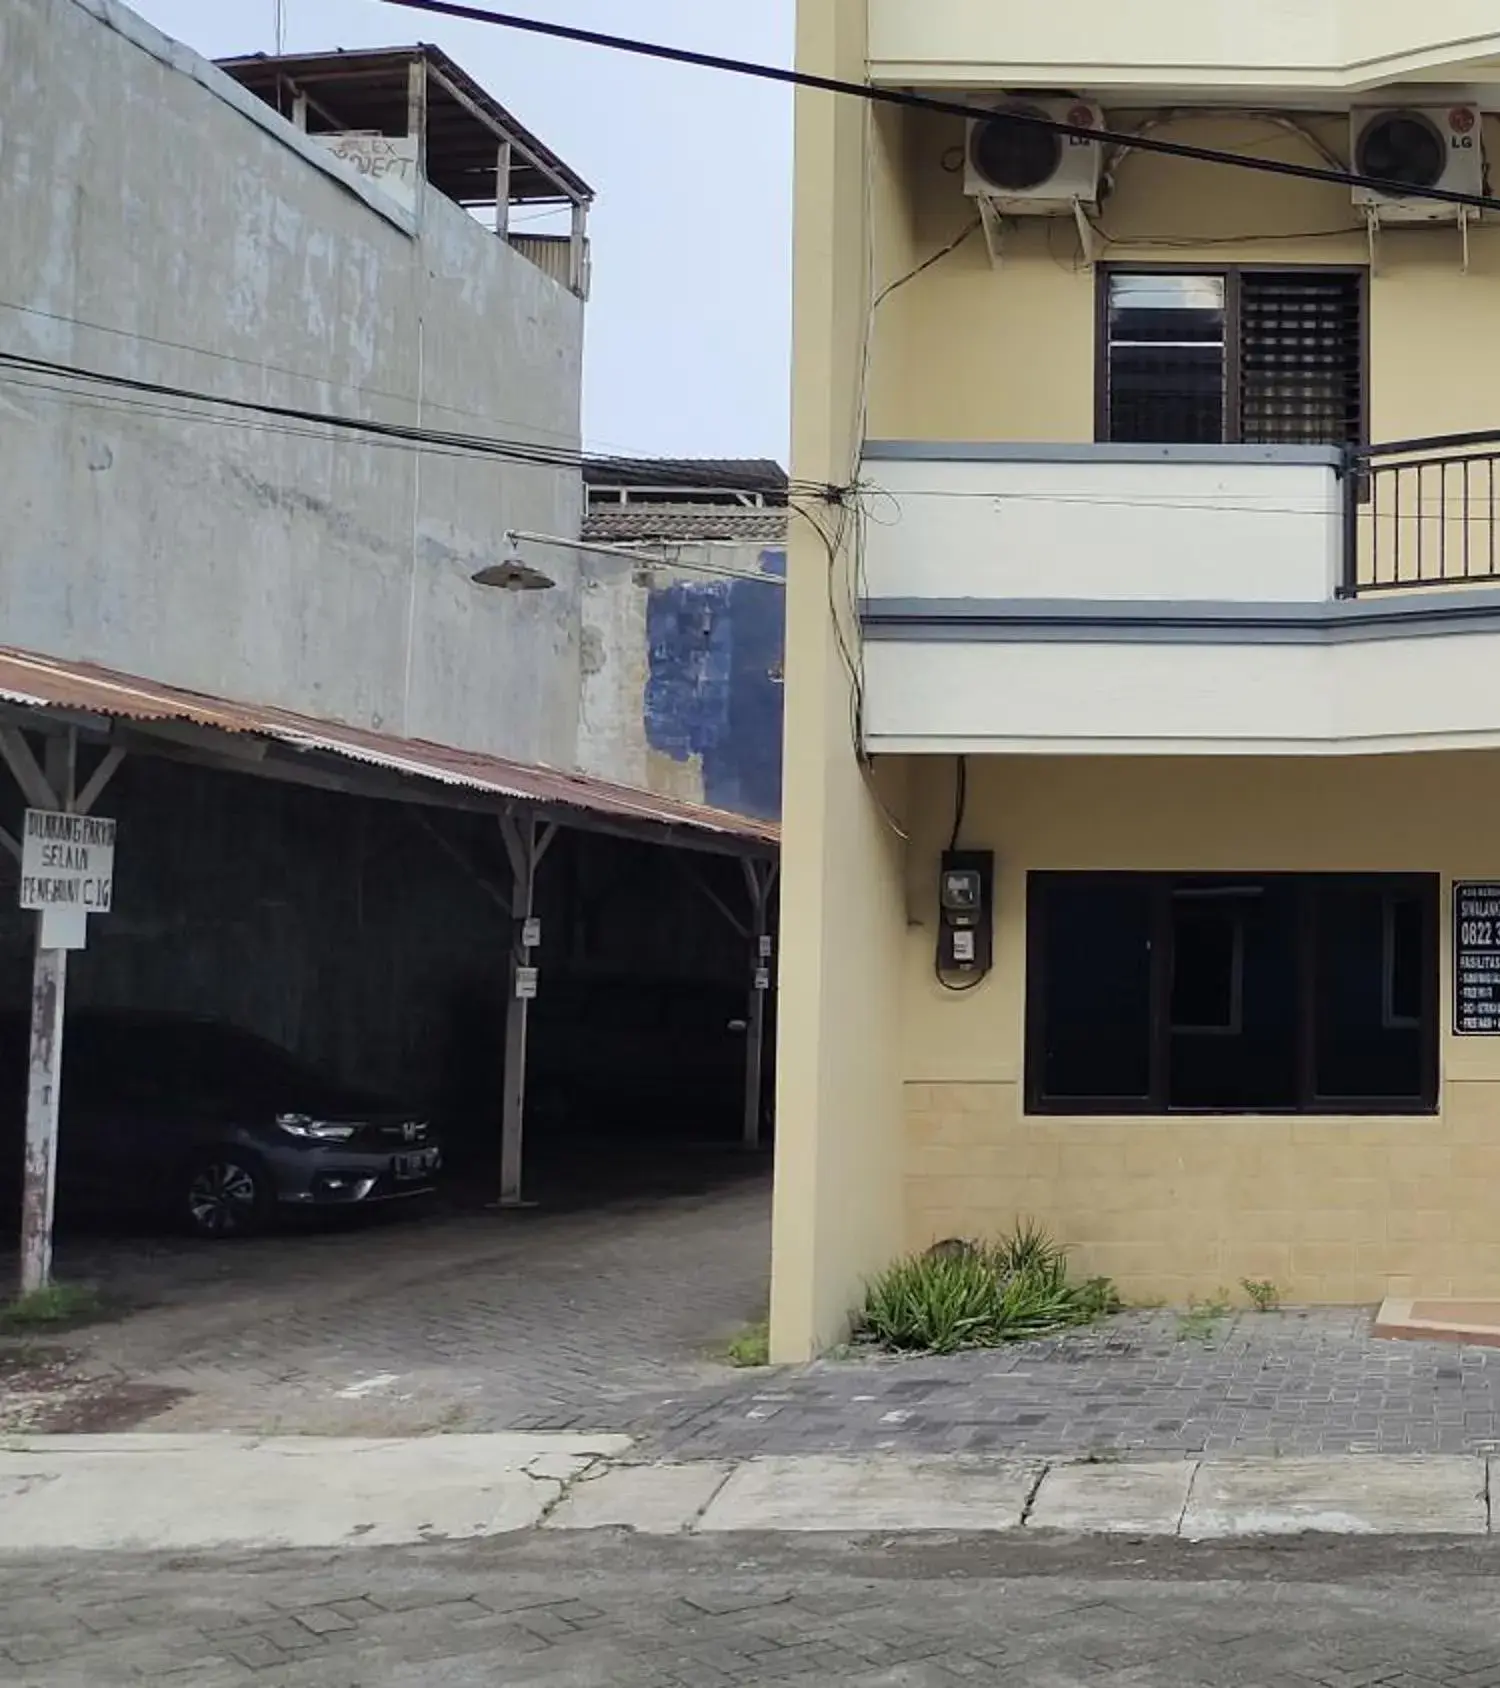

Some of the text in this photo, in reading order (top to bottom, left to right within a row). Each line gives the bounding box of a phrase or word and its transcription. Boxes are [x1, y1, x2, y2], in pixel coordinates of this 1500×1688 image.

[1451, 135, 1473, 148] LG
[42, 843, 88, 870] SELAIN
[1461, 922, 1492, 945] 0822
